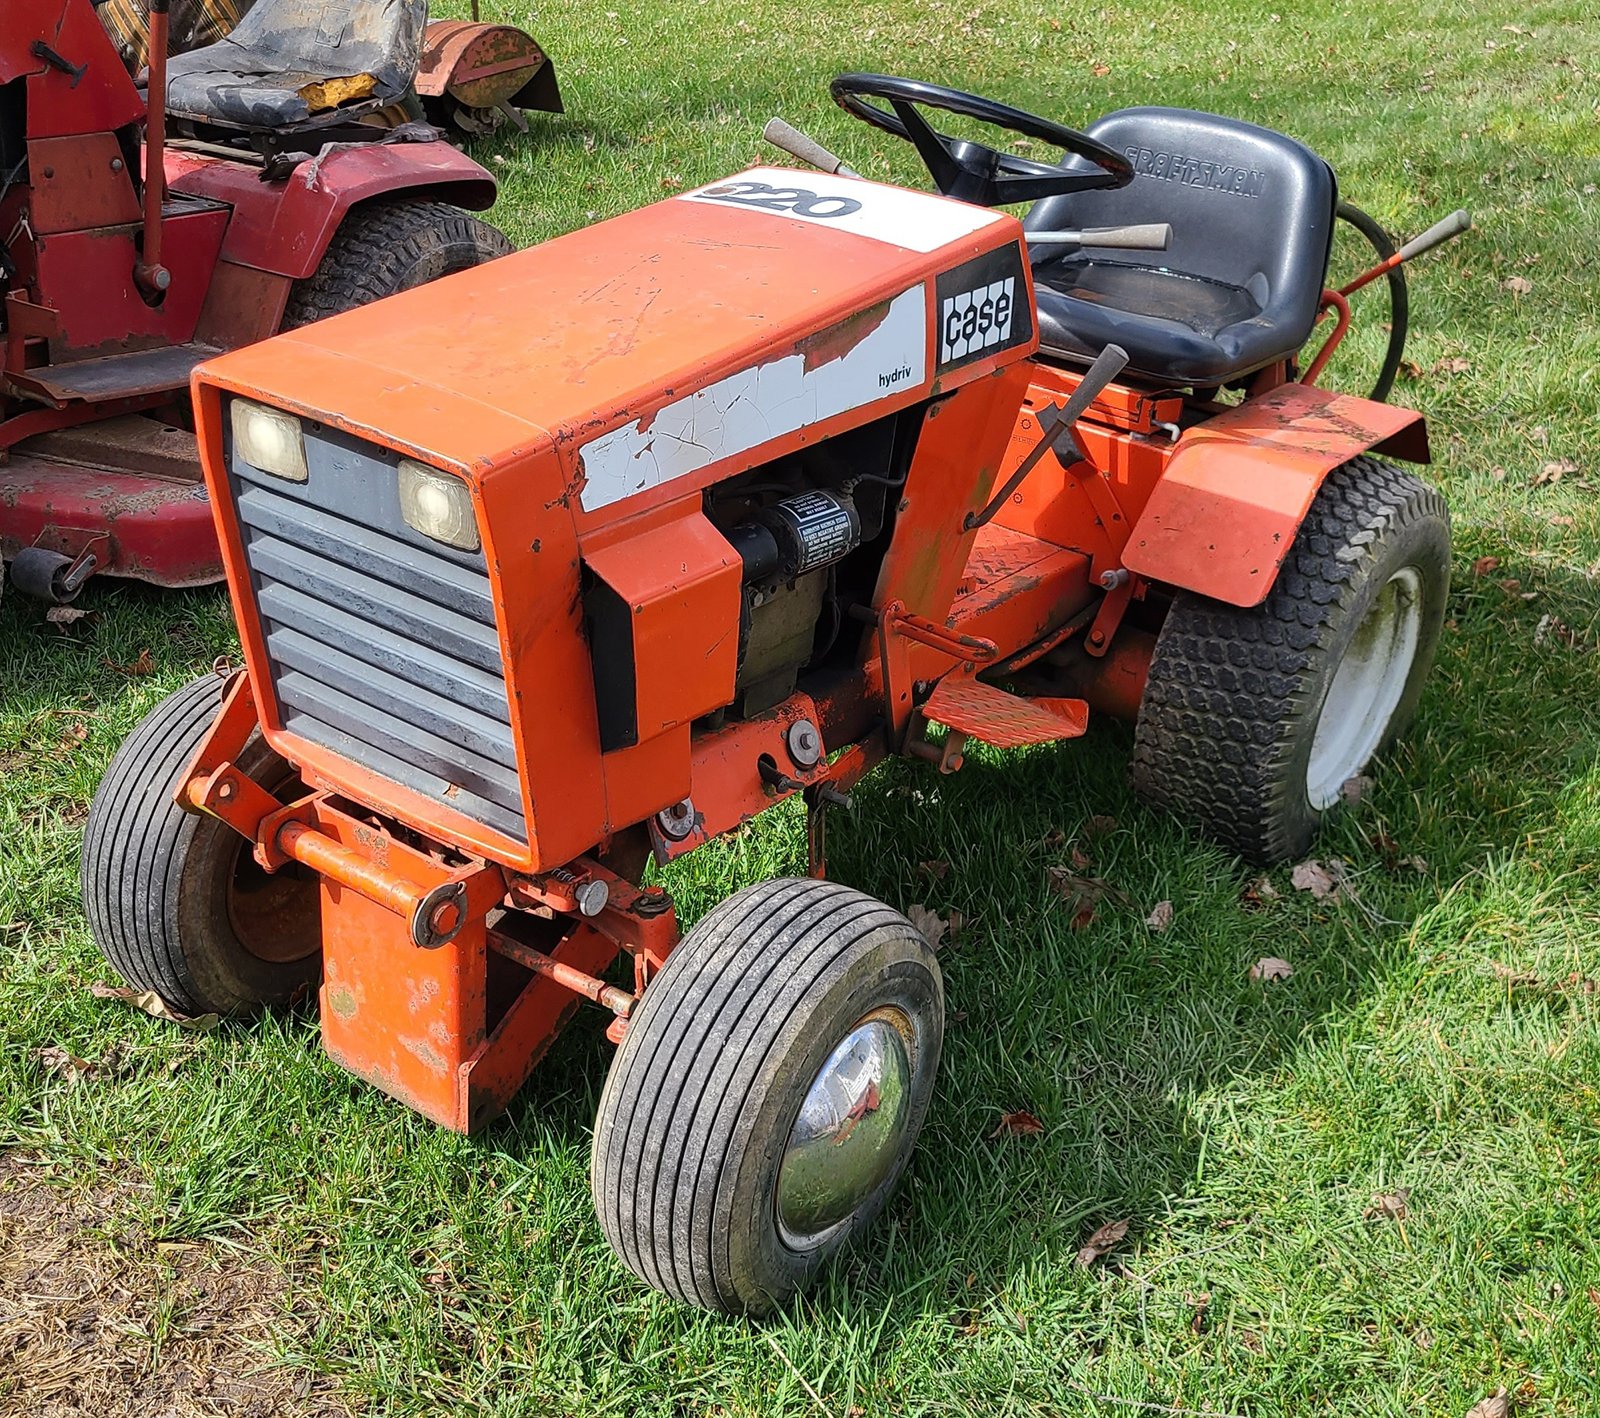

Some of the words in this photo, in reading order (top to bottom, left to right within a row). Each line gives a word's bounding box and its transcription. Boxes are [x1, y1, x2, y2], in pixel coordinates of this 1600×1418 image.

[1124, 146, 1265, 198] CRAFTSMAN
[945, 289, 1011, 352] case
[879, 366, 912, 387] hydriv
